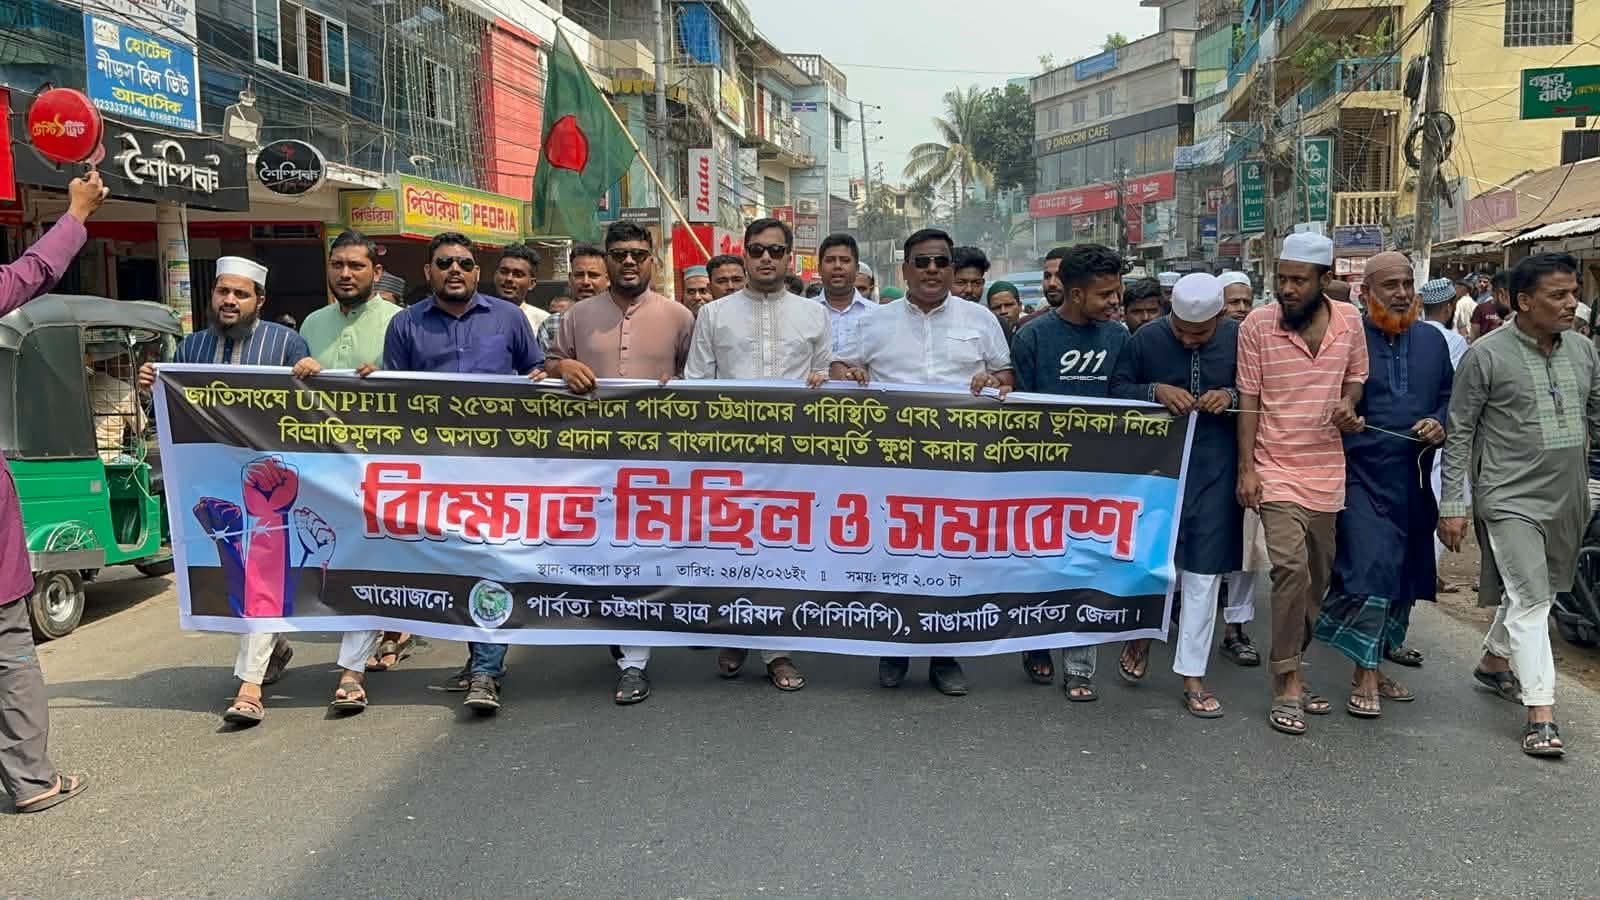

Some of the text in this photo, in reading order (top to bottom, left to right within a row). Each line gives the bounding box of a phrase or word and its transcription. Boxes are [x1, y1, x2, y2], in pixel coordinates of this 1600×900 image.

[125, 36, 172, 64] হোটেল
[137, 61, 161, 91] হিল
[164, 69, 190, 96] ভিউ
[112, 86, 183, 114] আবাসিক
[696, 155, 709, 215] Bata
[473, 203, 517, 233] PEORIA
[1060, 349, 1107, 374] 911
[183, 380, 1173, 439] জাতিসংঘে UNPFII এর ২৫তম অধিবেশনে পার্বত্য চট্টগ্রামের পরিস্থিতি এবং সরকারের ভূমিকা নিয়ে
[278, 416, 403, 452] বিভ্রান্তিমূলক
[411, 428, 428, 445] ও
[436, 427, 500, 449] অসত্য
[506, 428, 552, 448] তথ্য
[557, 427, 613, 451] প্রদান
[617, 431, 661, 452] করে
[669, 430, 784, 454] বাংলাদেশের
[792, 430, 872, 463] ভাবমূর্তি
[921, 441, 977, 462] করার
[984, 438, 1072, 464] প্রতিবাদে
[361, 461, 1141, 557] বিক্ষোভ মিছিল ও সমাবেশ
[569, 564, 610, 577] বনরূপা
[676, 563, 715, 578] তারিখ:
[845, 570, 877, 584] সময়:
[882, 571, 908, 586] দুপুর
[913, 575, 944, 587] ২.০০
[949, 573, 962, 588] টা
[352, 583, 454, 612] আয়োজনে:
[527, 592, 591, 618] পার্বত্য
[599, 594, 666, 622] চট্টগ্রাম
[670, 600, 712, 625] ছাত্র
[718, 598, 785, 626] পরিষদ
[792, 600, 911, 636] (পিসিসিপি),
[918, 603, 1001, 633] রাঙামাটি
[1007, 600, 1070, 625] পার্বত্য
[1076, 604, 1129, 624] জেলা
